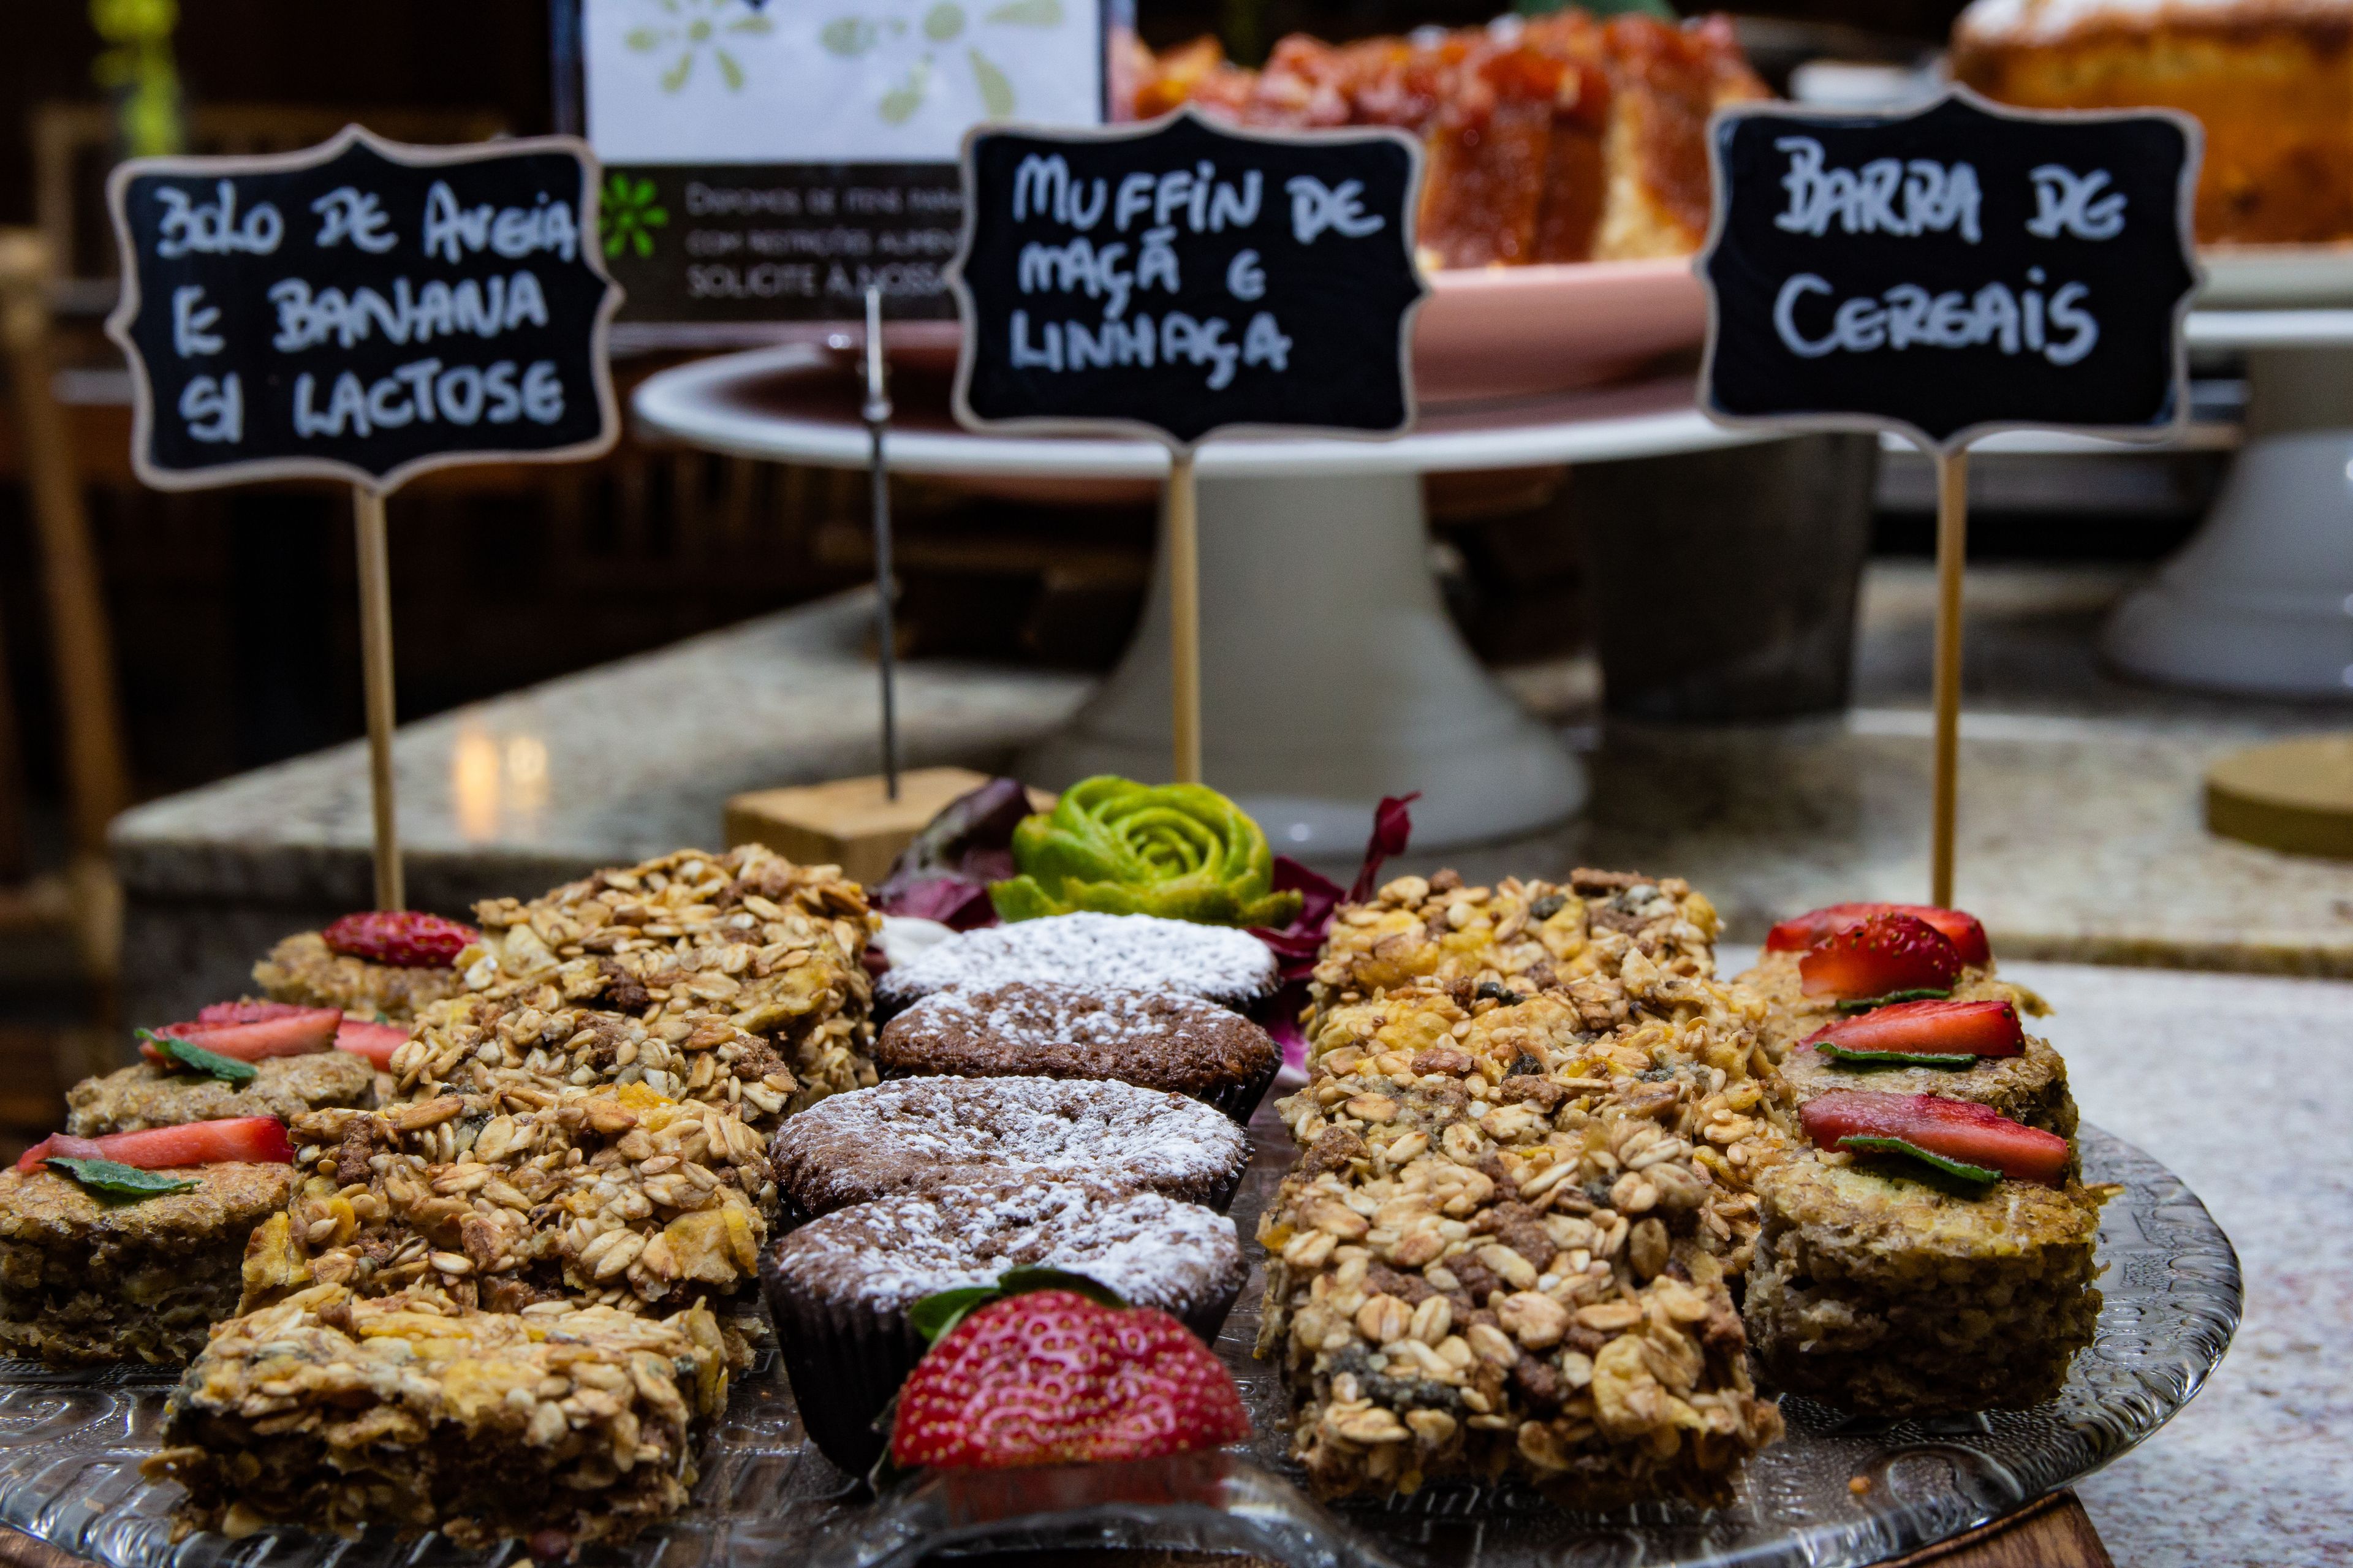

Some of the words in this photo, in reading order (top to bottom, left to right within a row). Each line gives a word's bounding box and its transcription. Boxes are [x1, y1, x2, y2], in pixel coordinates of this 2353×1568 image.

[312, 186, 398, 254] DE
[1013, 153, 1264, 232] MUFFIN
[1286, 175, 1385, 243] DE
[1773, 136, 1982, 243] BARRA
[2025, 164, 2127, 240] DE
[171, 285, 225, 359] E
[268, 270, 548, 352] BANANA
[686, 263, 817, 297] SOLICITE
[1018, 224, 1181, 320] MAÇÃ
[1227, 249, 1267, 301] E
[1773, 266, 2099, 366] CEREAIS
[1009, 308, 1293, 391] LINHAÇA
[294, 357, 566, 439] LACTOSE
